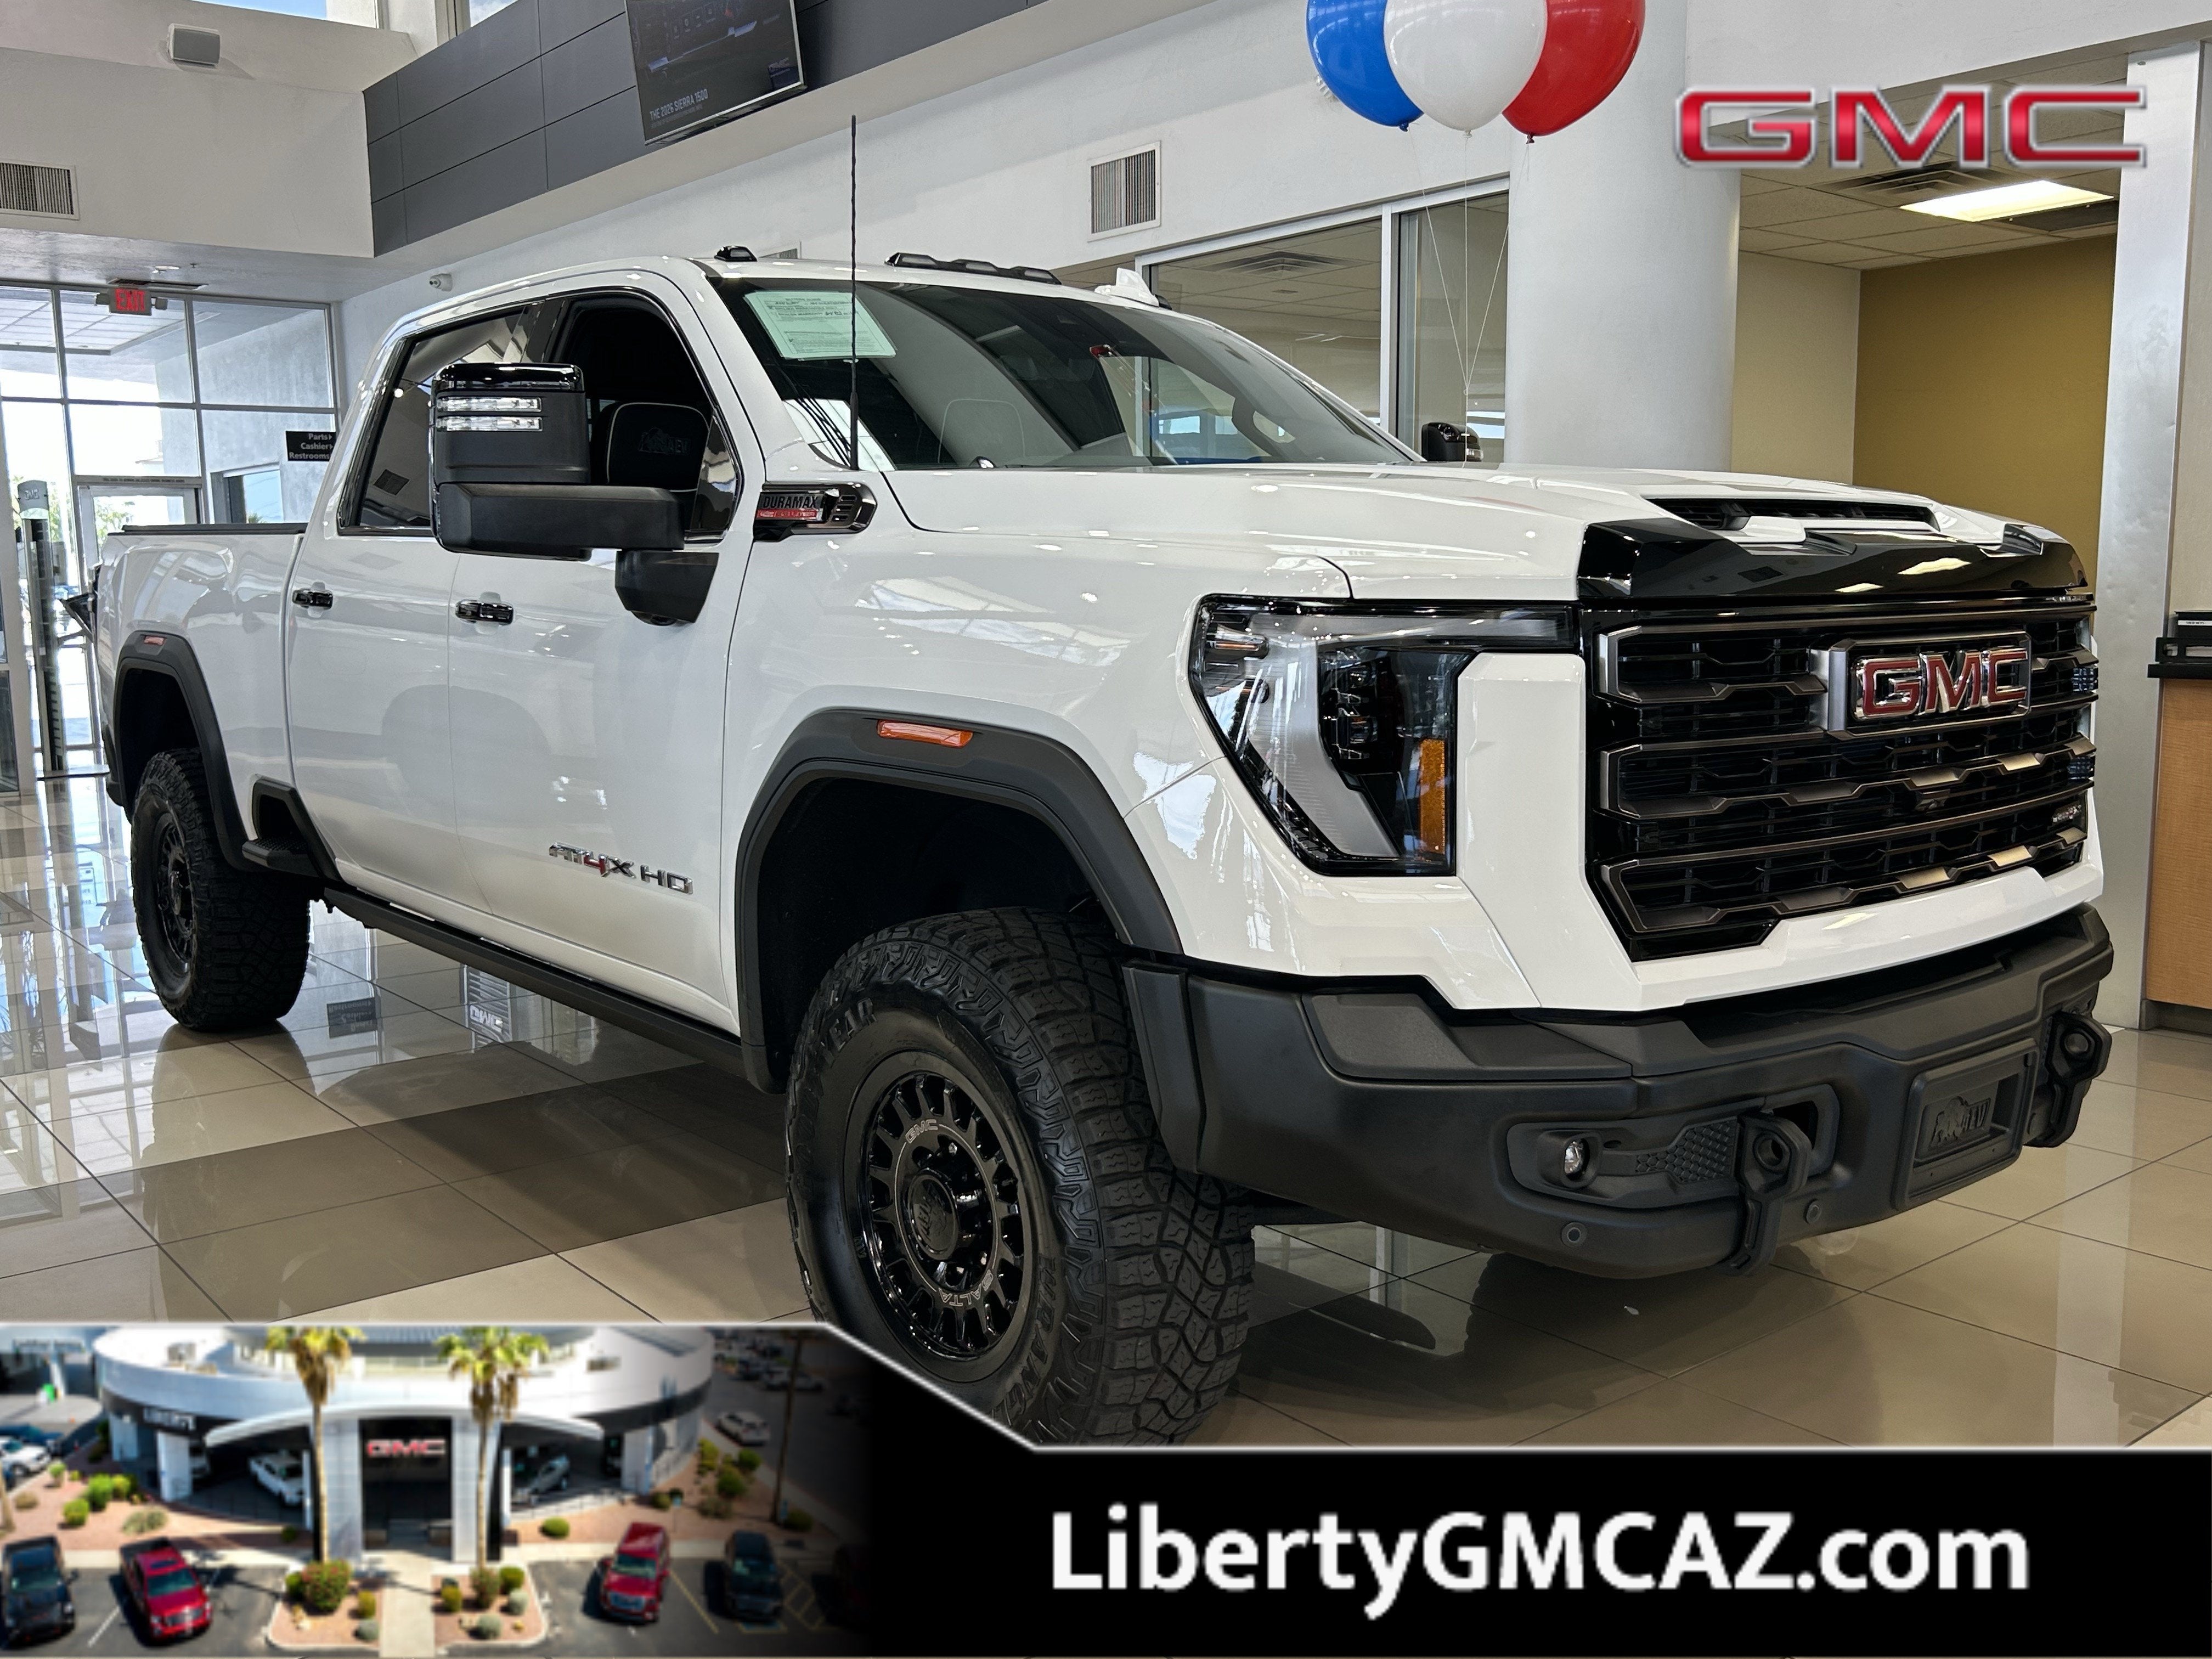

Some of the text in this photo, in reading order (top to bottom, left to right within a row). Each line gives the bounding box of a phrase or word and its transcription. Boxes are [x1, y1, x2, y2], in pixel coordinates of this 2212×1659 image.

[650, 108, 661, 120] THE
[674, 94, 695, 111] SIERRA
[694, 88, 708, 103] 1500
[115, 288, 145, 312] EXIT
[289, 452, 330, 460] Restrooms
[763, 495, 818, 509] DURAMAX
[1855, 647, 2029, 718] GMC
[549, 842, 693, 895] AT4X HD
[821, 997, 877, 1068] YEAR
[905, 1119, 938, 1143] GMC
[938, 1269, 994, 1307] SALTA
